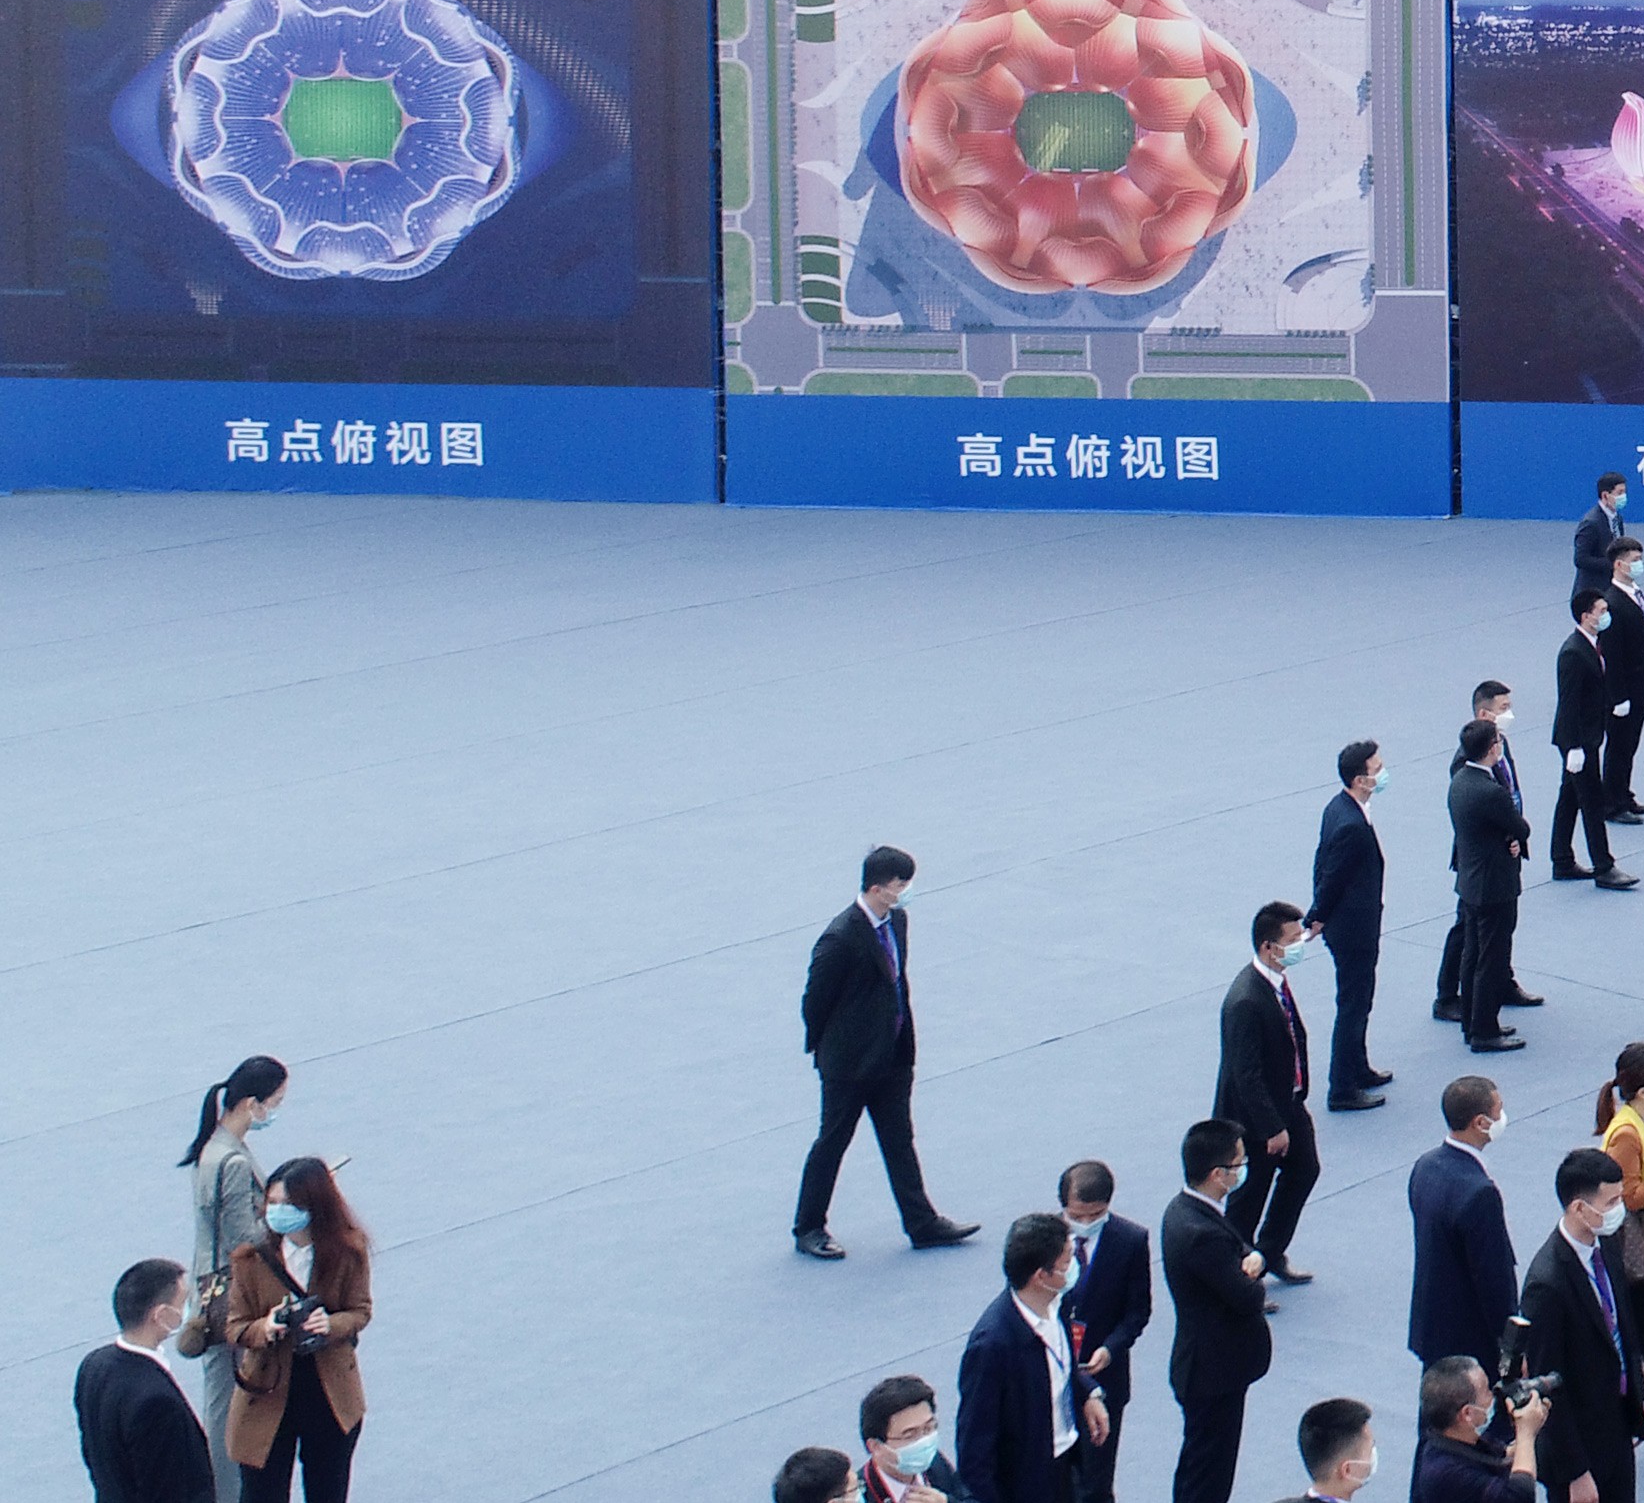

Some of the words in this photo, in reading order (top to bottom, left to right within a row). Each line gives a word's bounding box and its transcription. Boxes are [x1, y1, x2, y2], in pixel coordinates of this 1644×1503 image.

[225, 418, 484, 466] 高点俯视图
[956, 432, 1219, 480] 高点俯视图
